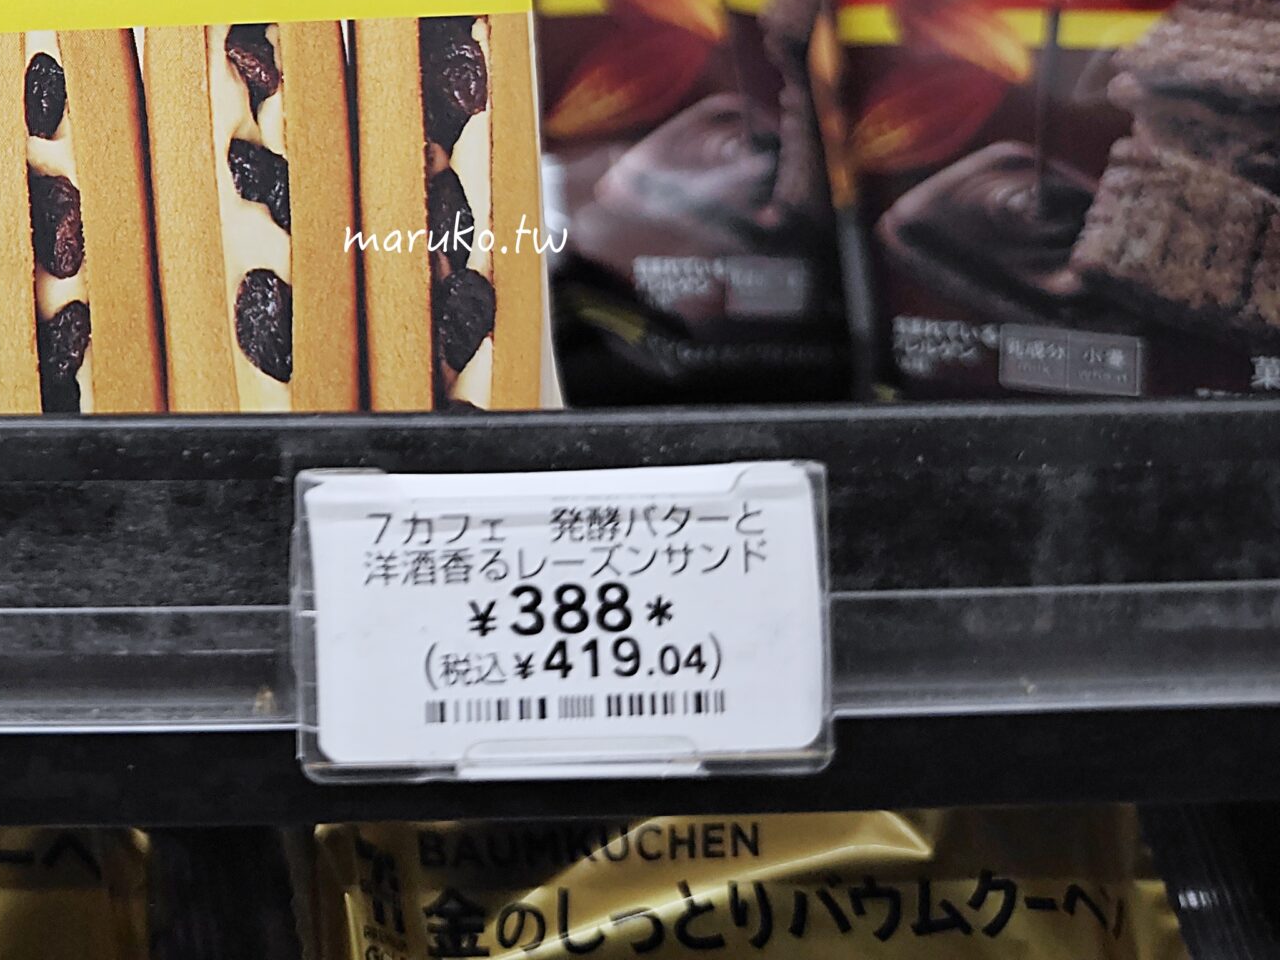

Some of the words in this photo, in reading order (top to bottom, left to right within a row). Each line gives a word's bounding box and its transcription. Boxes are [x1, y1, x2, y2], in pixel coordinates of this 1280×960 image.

[549, 501, 767, 542] 発酵バターと
[364, 539, 768, 587] 洋酒香るレーズンサンド
[418, 822, 761, 869] BAUMKUCHEN
